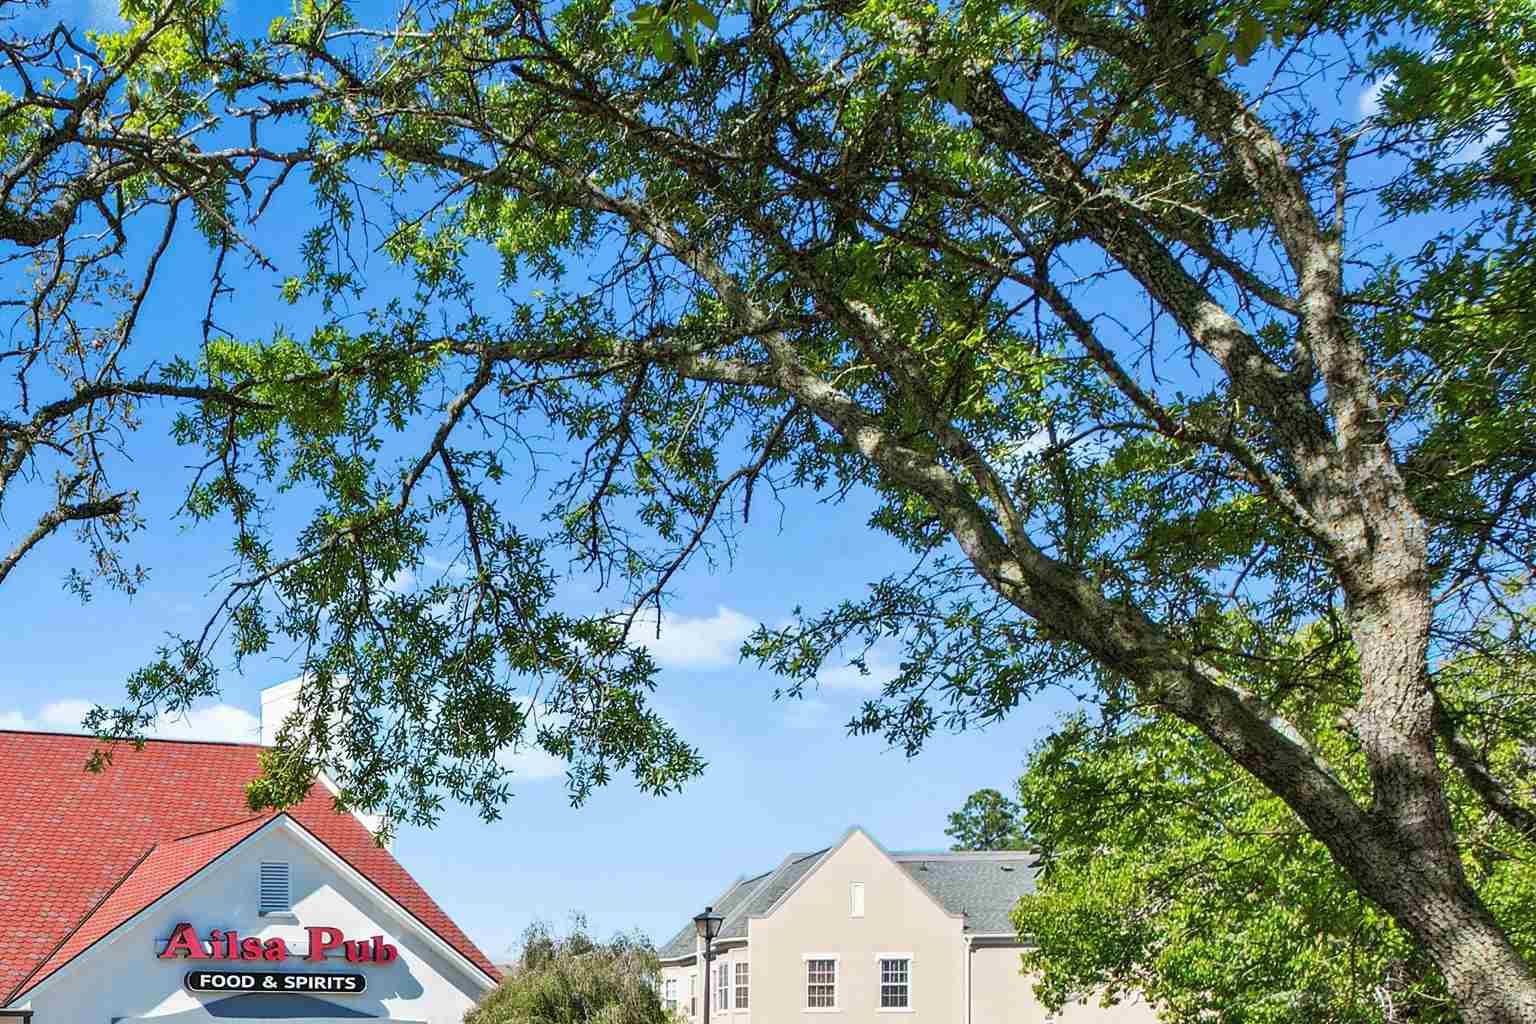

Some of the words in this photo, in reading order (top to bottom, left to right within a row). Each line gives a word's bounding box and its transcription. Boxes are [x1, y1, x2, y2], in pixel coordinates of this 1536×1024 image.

[158, 922, 288, 962] Ailsa
[304, 926, 399, 963] Pub
[199, 974, 255, 989] FOOD
[262, 975, 278, 989] &
[284, 975, 357, 990] SPIRITS
